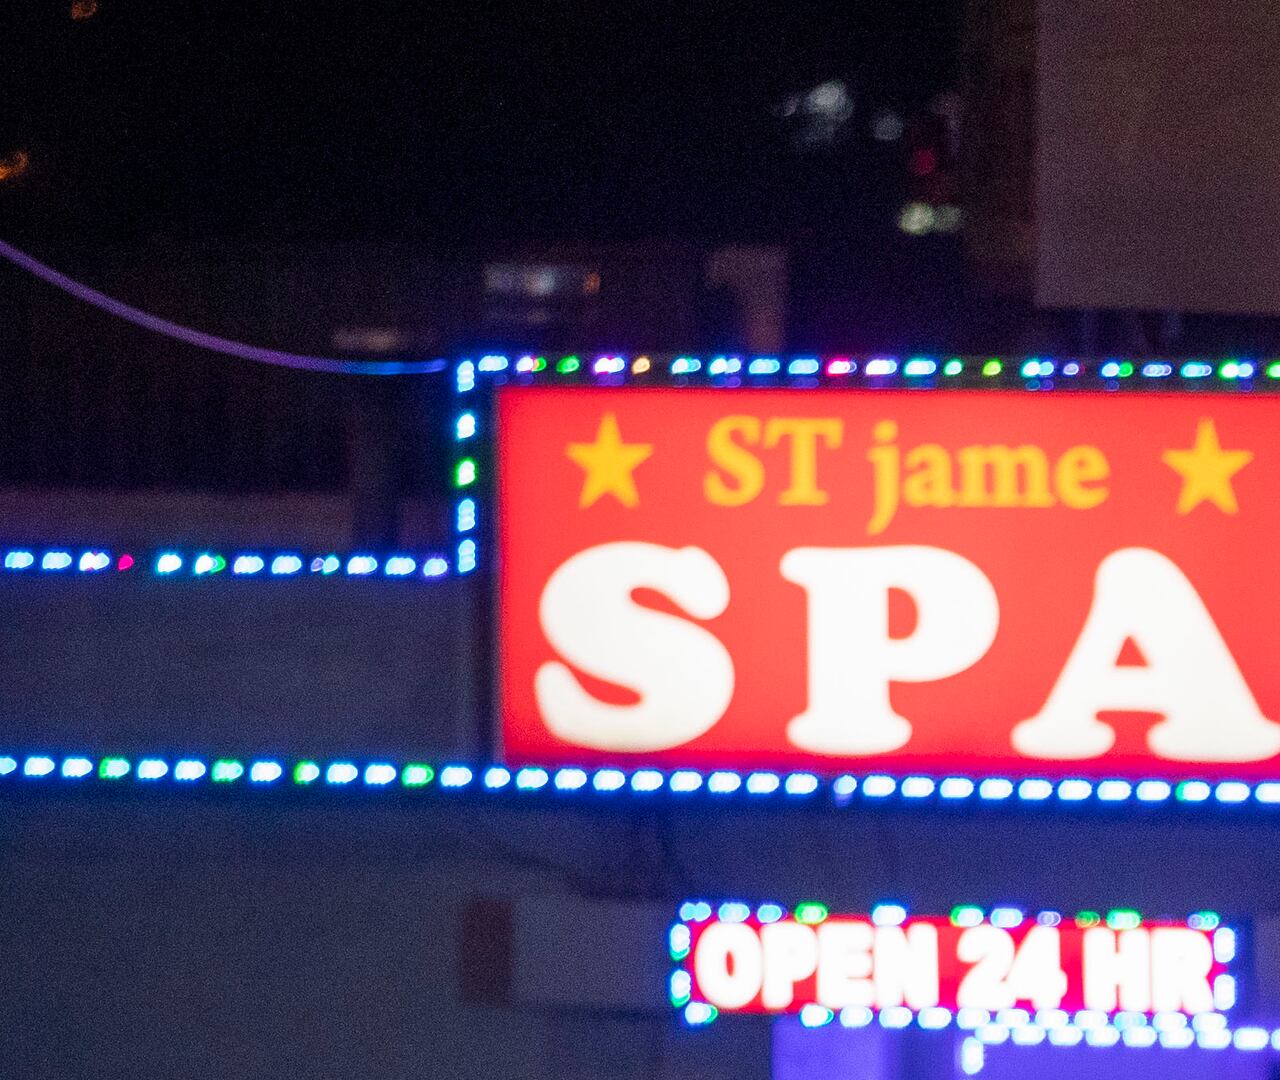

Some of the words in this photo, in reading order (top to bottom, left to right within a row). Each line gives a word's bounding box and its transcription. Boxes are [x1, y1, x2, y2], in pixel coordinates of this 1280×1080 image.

[703, 415, 844, 508] ST
[865, 418, 1110, 536] jame
[694, 921, 939, 1010] OPEN
[955, 924, 1067, 1011] 24
[1083, 926, 1214, 1013] HR
